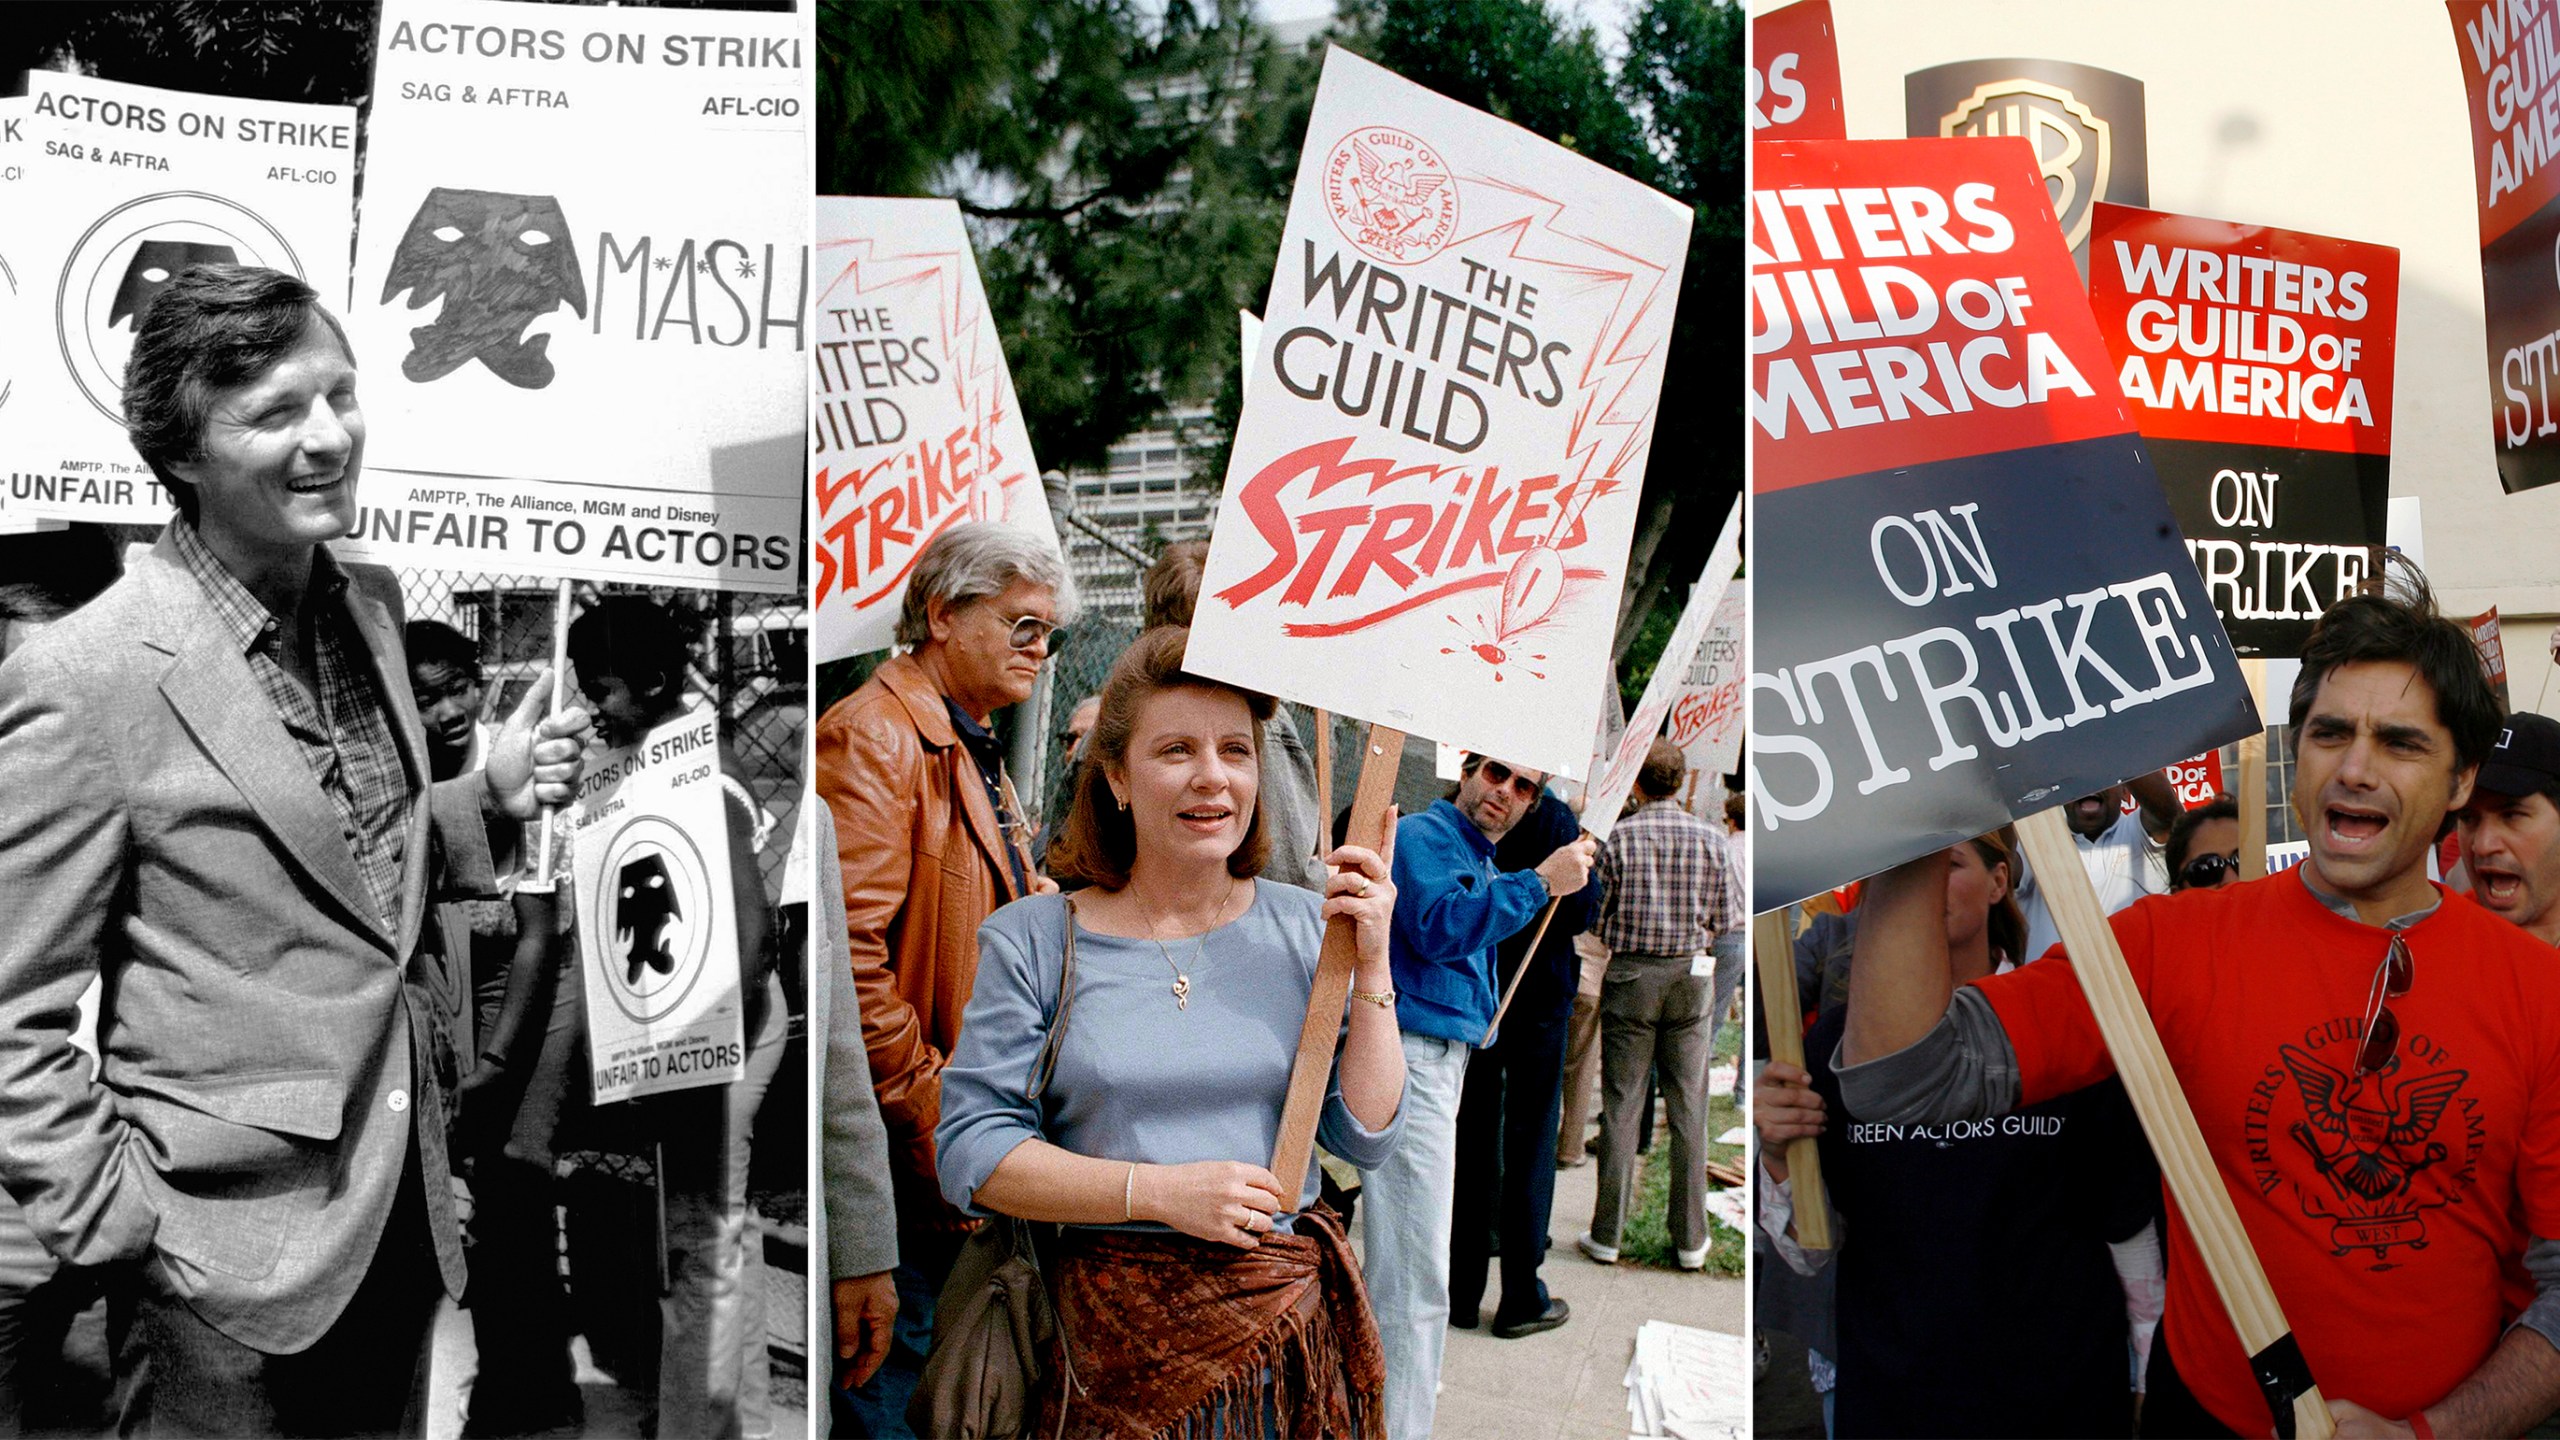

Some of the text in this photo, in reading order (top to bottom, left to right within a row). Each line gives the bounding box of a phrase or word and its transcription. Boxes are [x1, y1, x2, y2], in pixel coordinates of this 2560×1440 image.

[388, 20, 566, 60] ACTORS
[582, 32, 646, 65] ON
[34, 91, 166, 133] ACTORS
[178, 112, 224, 139] ON
[237, 118, 350, 149] STRIKE
[401, 82, 570, 109] SAG & AFTRA
[702, 97, 800, 117] AFL-CIO
[45, 141, 170, 171] SAG & AFTRA
[1329, 150, 1351, 220] WRITERS
[1369, 133, 1414, 151] GUILD
[1418, 149, 1438, 168] OF
[1461, 257, 1538, 321] THE
[1945, 276, 2032, 331] OF
[2113, 239, 2369, 322] WRITERS
[828, 307, 893, 333] THE
[1305, 239, 1573, 408] WRITERS
[2126, 299, 2362, 373] GUILD OF
[816, 336, 940, 396] ITERS
[1273, 326, 1490, 454] GUILD
[2118, 355, 2374, 427] AMERICA
[12, 473, 133, 505] UNFAIR
[110, 463, 131, 474] The
[408, 488, 720, 527] AMPTP, The Alliance, MGM and Disney
[2210, 468, 2279, 529] ON
[526, 518, 586, 555] TO
[601, 524, 791, 571] ACTORS
[1870, 502, 1998, 607] ON
[2184, 538, 2369, 621] RIKE
[1695, 641, 1737, 662] RITERS
[1753, 571, 2215, 831] STRIKE
[576, 723, 714, 799] CTORS ON STRIKE
[672, 765, 711, 789] AFL-CIO
[2184, 766, 2207, 782] OF
[2175, 781, 2216, 804] ICA
[596, 1043, 741, 1091] UNFAIR TO ACTORS
[1847, 1124, 1904, 1143] REEN
[2245, 1063, 2286, 1197] WRITERS
[2409, 1034, 2449, 1068] OF
[2356, 1226, 2401, 1243] WEST
